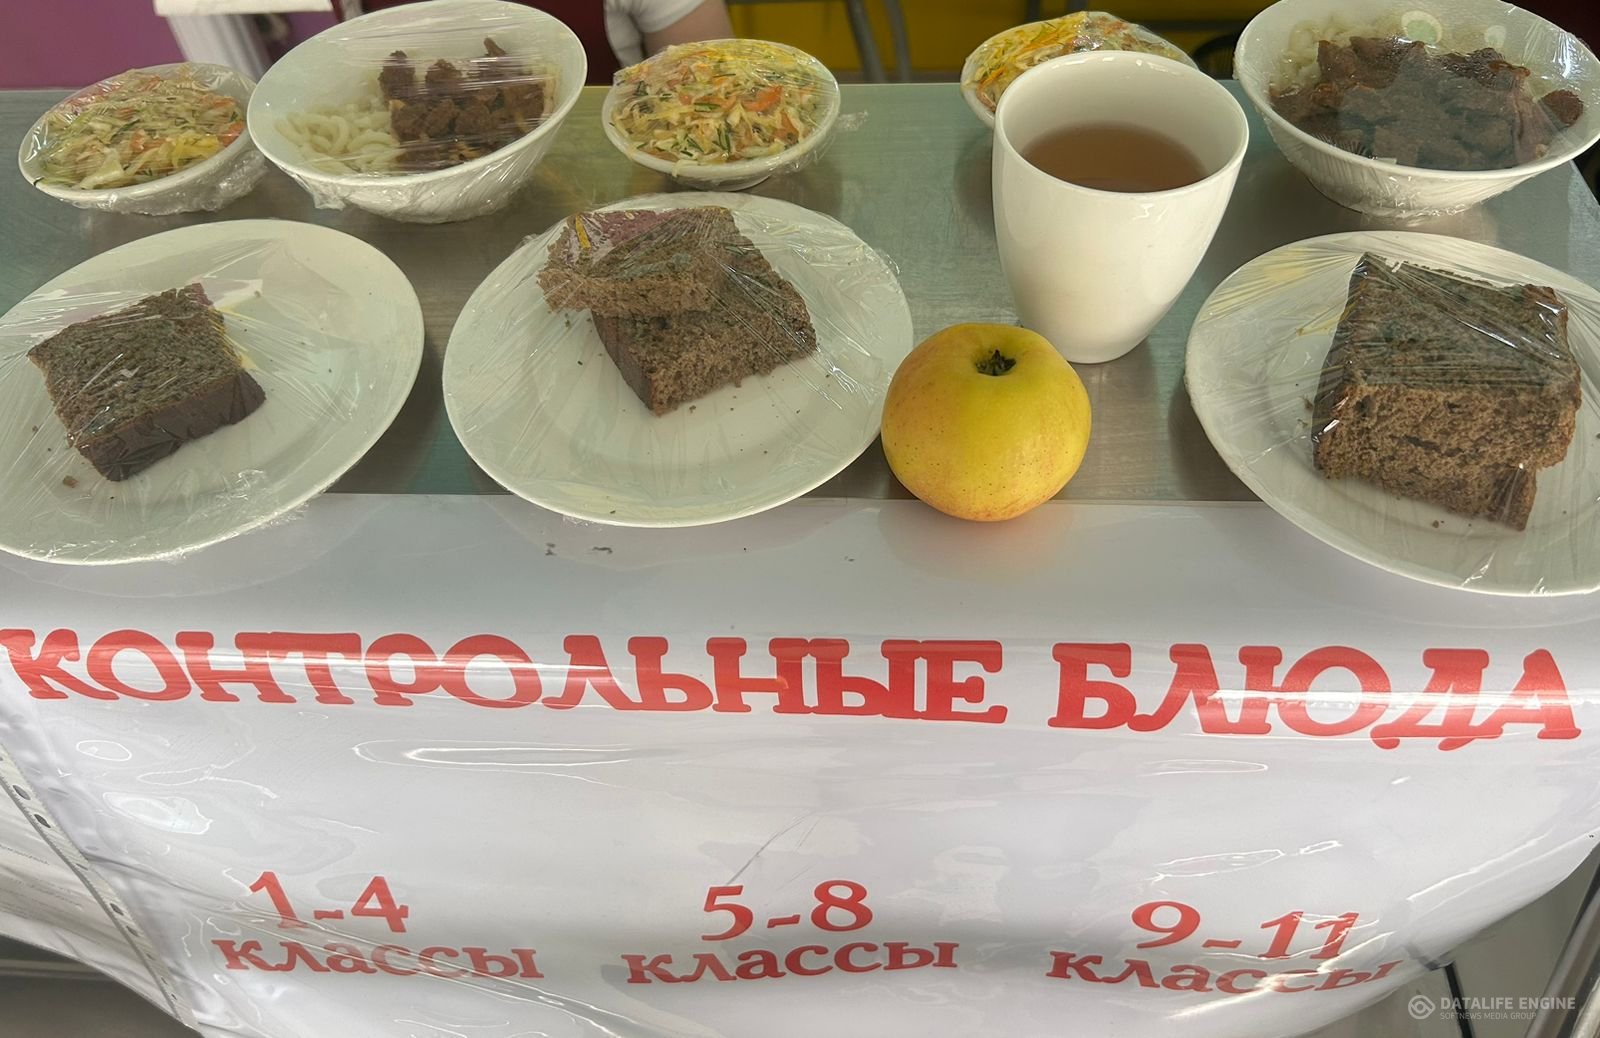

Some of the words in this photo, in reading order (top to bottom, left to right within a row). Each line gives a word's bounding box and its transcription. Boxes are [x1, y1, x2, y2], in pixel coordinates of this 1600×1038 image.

[0, 627, 1008, 724] КОНТРОЛЬНЫЕ
[1048, 643, 1581, 751] БЛЮДА
[249, 872, 409, 933] 1-4
[704, 881, 873, 941] 5-8
[1132, 901, 1359, 961] 9-11
[212, 938, 545, 979] классы
[622, 942, 959, 984] классы
[1047, 951, 1403, 994] классы
